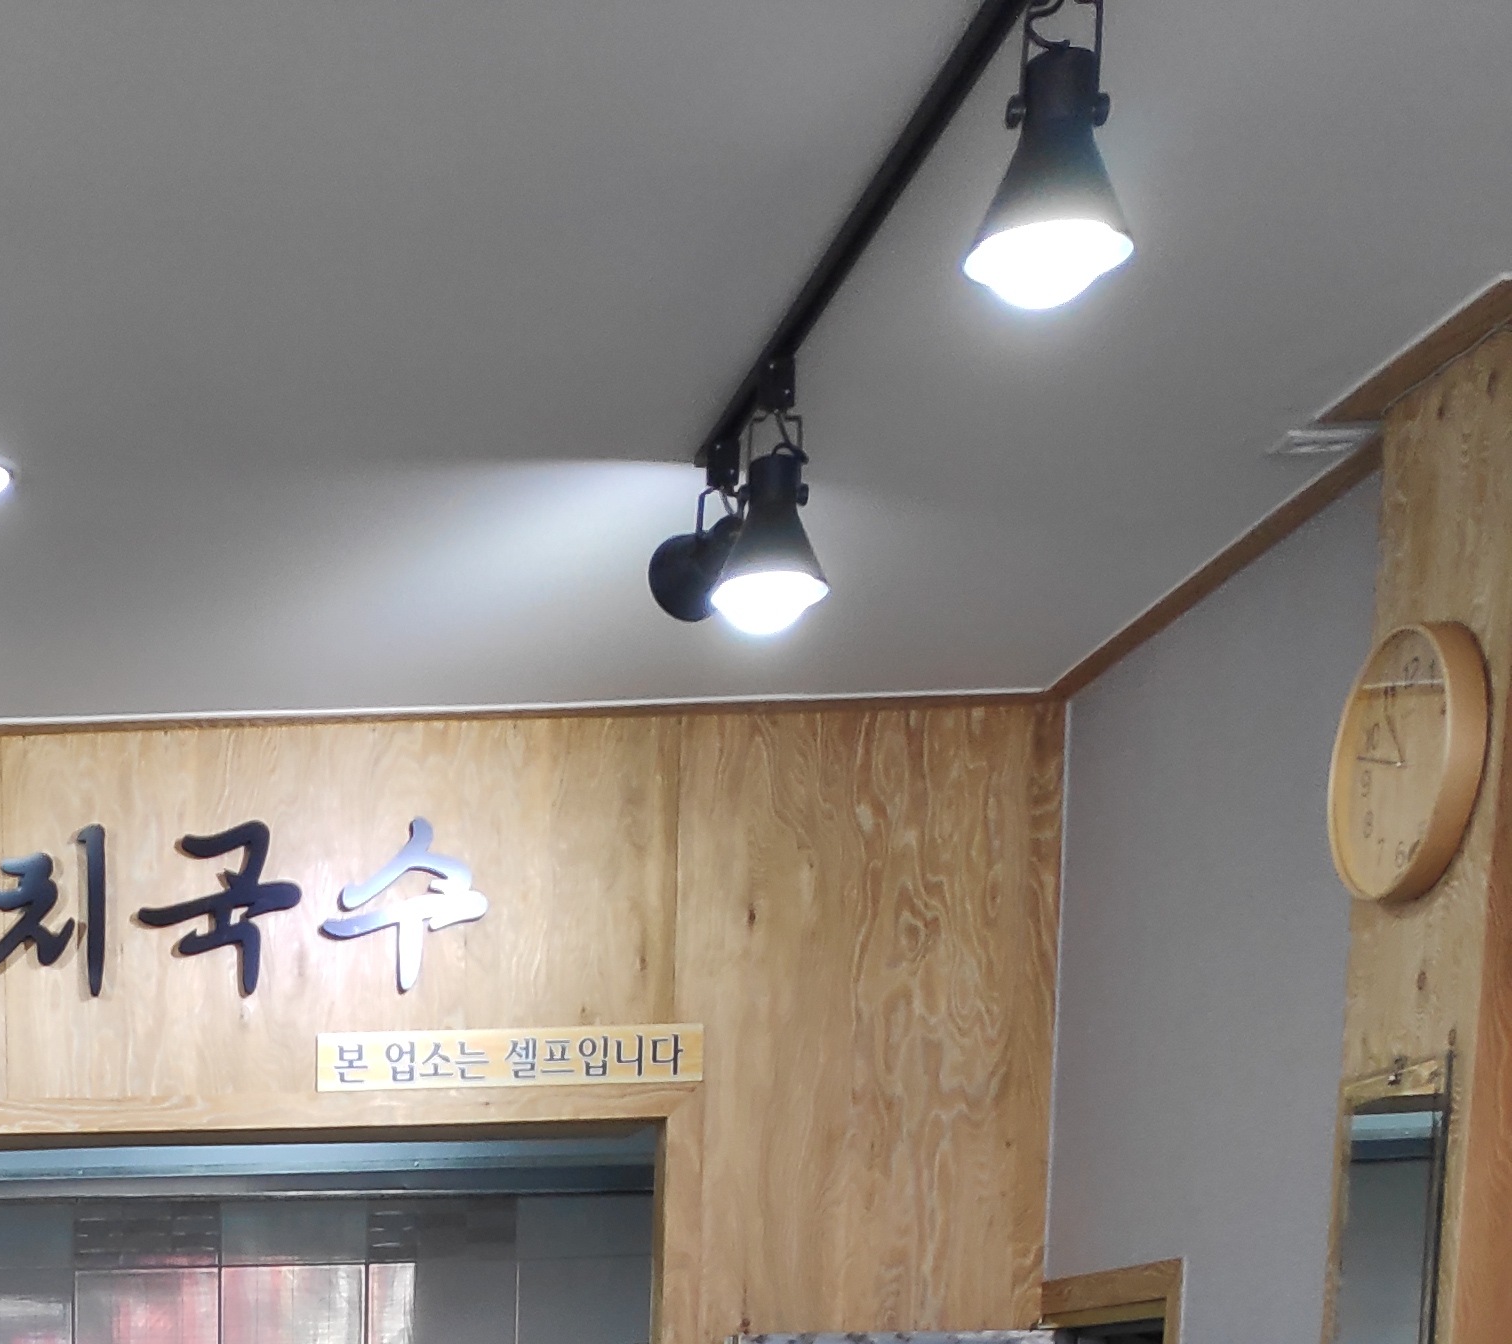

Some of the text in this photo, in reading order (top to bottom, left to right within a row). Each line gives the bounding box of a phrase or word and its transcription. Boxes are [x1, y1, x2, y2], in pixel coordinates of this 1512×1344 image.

[333, 1033, 683, 1083] 본 업소는 셀프입니다
